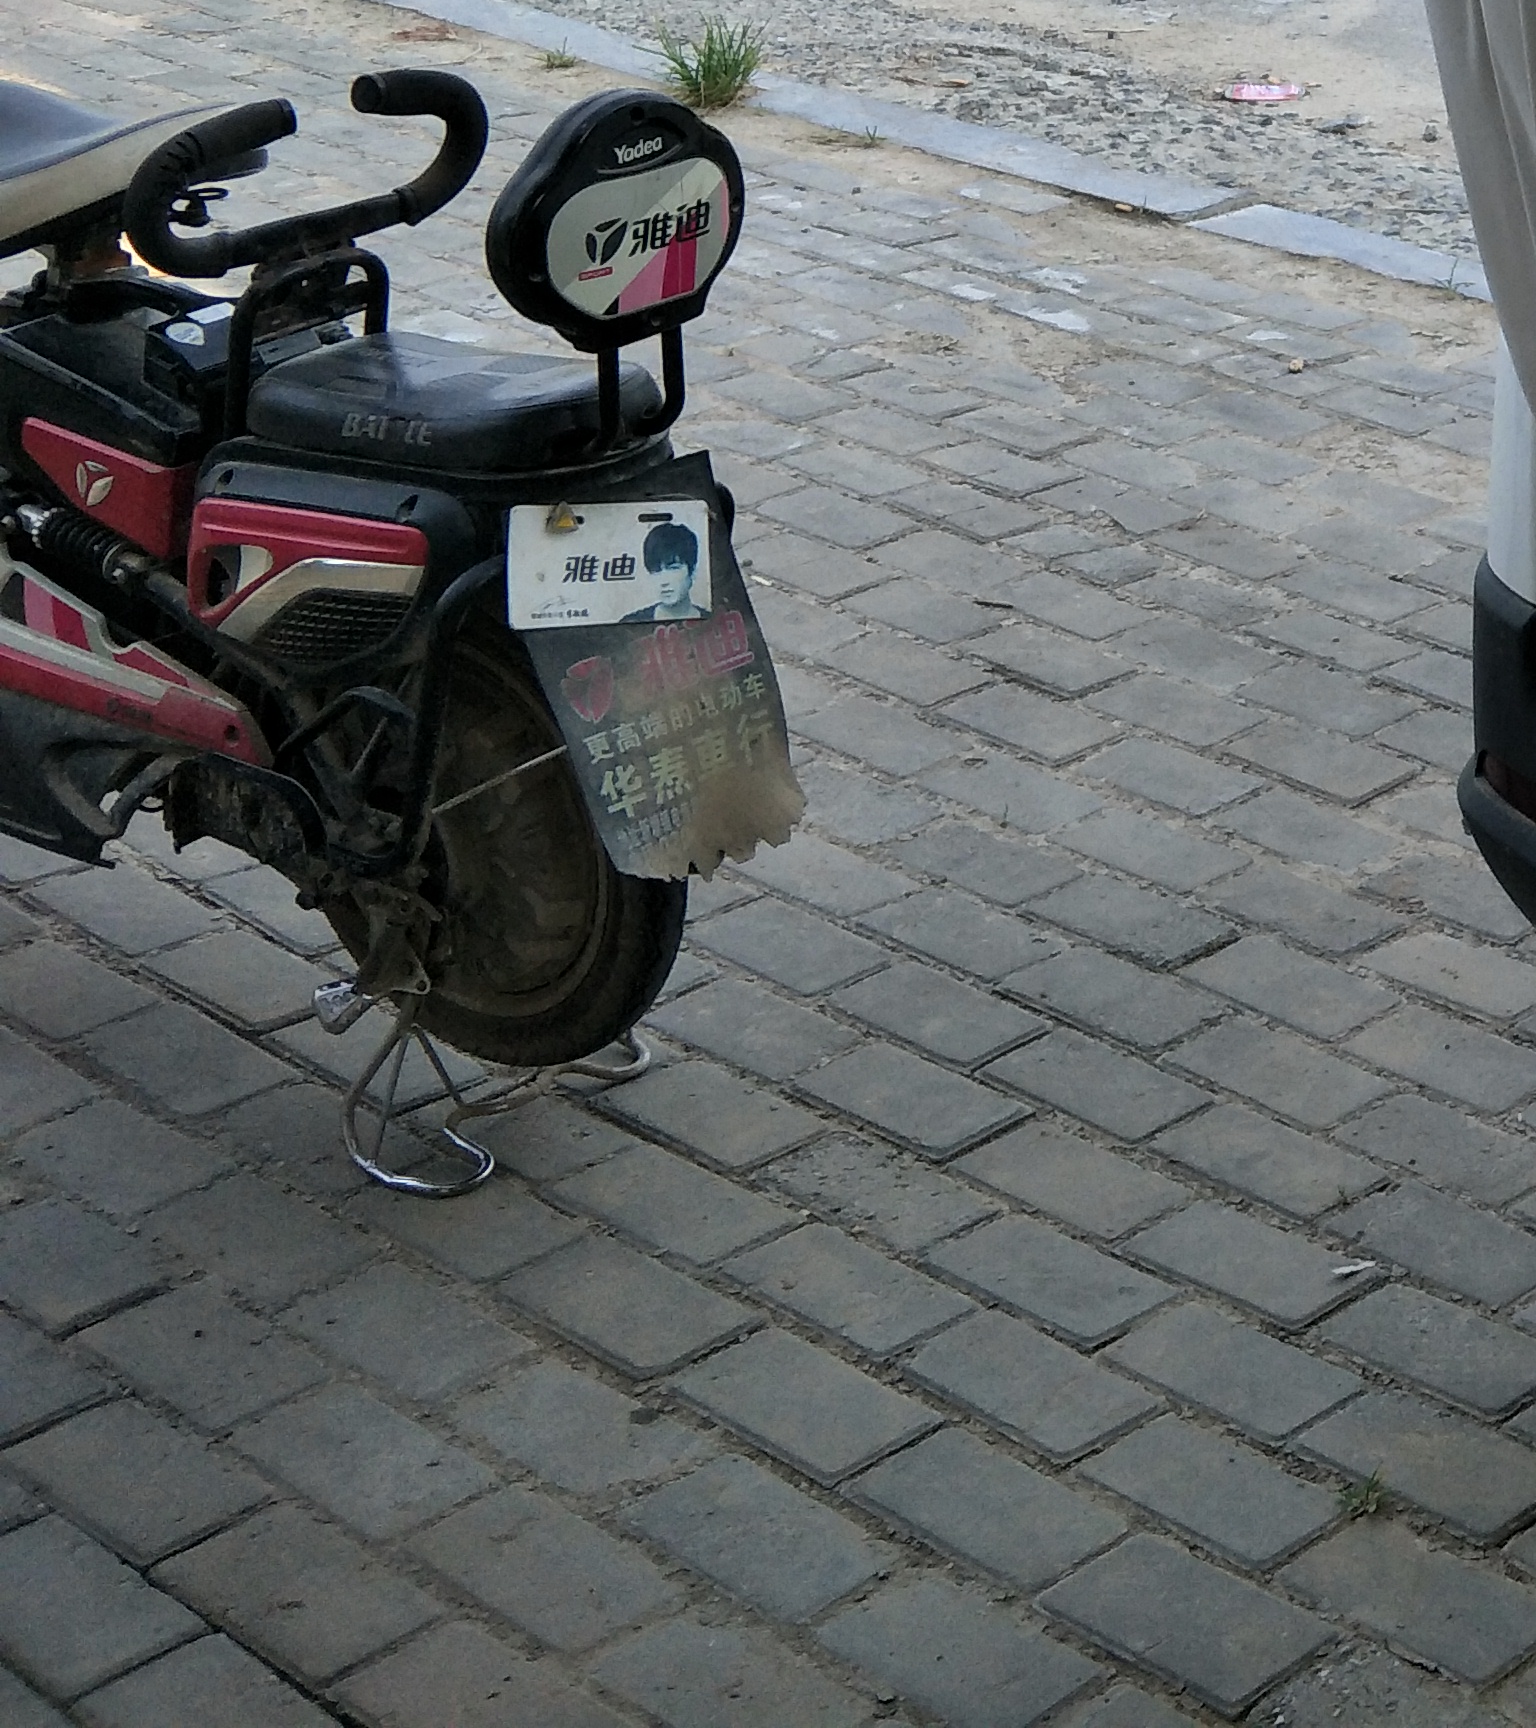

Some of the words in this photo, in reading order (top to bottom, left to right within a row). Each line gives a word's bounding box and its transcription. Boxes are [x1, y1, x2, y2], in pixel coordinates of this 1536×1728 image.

[613, 136, 663, 164] Yadea
[628, 198, 711, 258] 雅迪
[341, 412, 432, 446] BATLE
[562, 553, 636, 584] 雅迪
